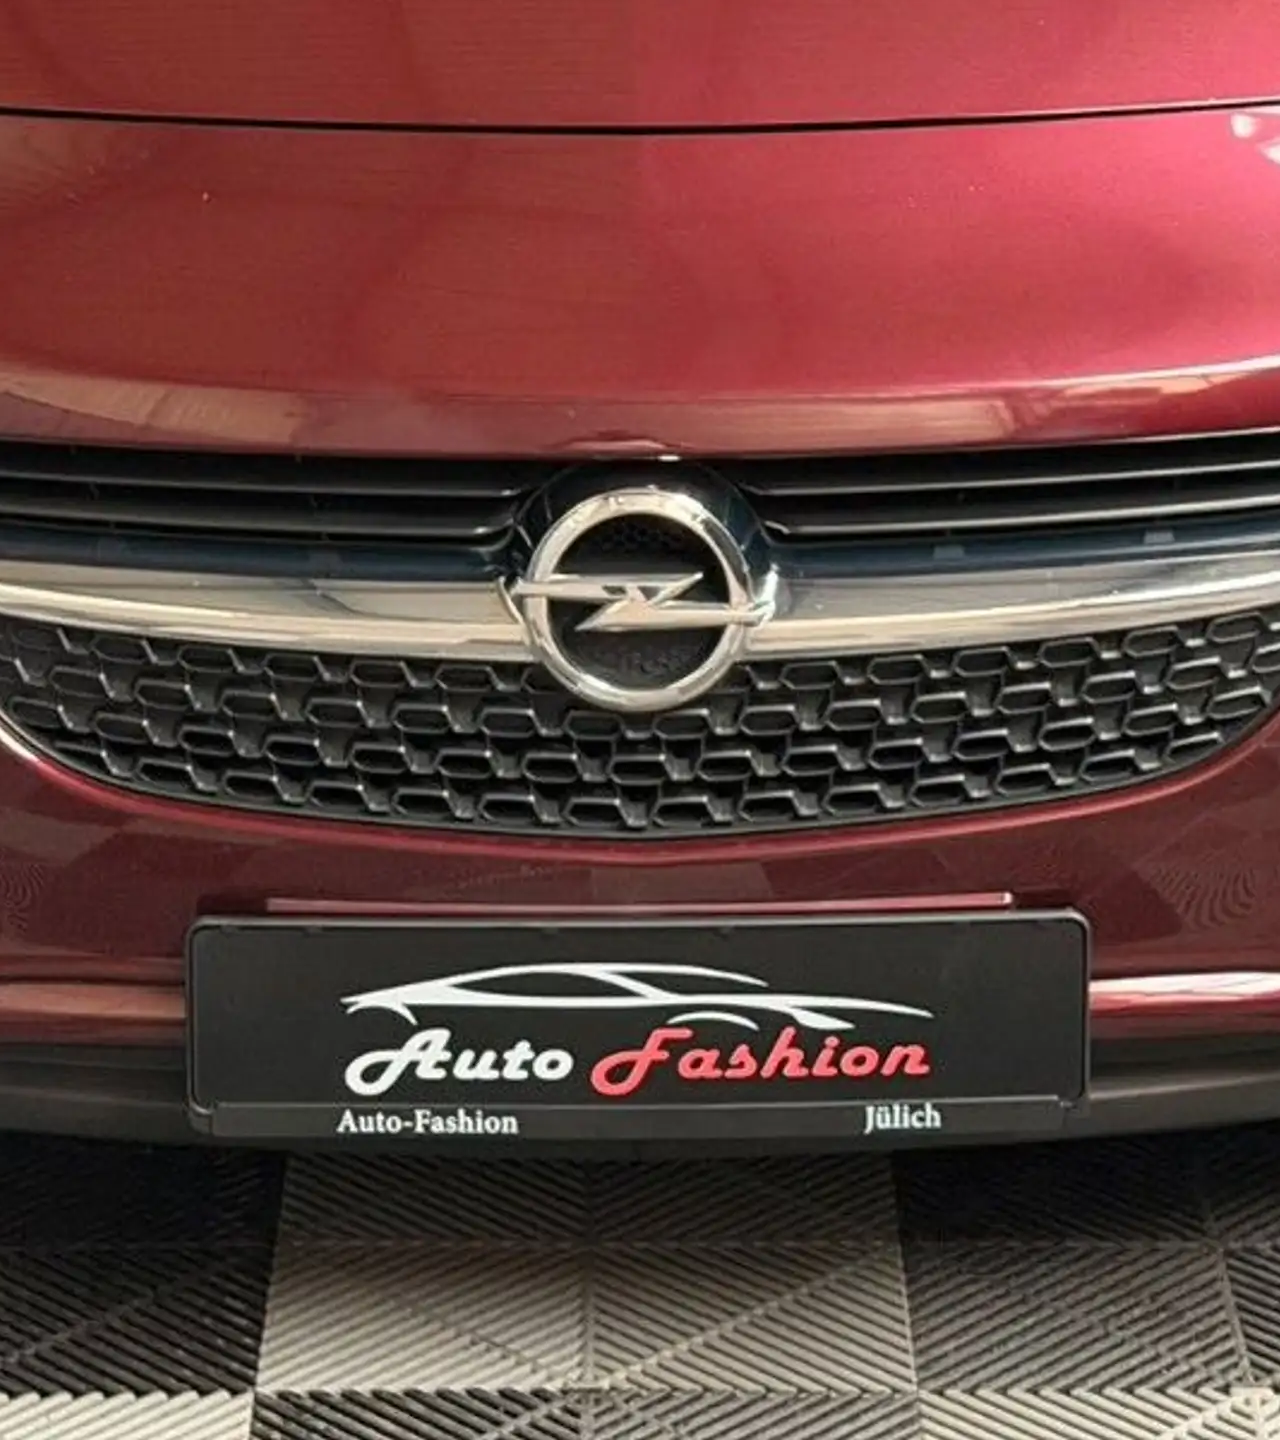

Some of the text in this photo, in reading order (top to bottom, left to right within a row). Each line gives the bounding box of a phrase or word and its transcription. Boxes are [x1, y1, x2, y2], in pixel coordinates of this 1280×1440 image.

[344, 1025, 931, 1097] Auto Fashion
[336, 1107, 519, 1135] Auto-Fashion
[863, 1105, 942, 1133] Jülich
